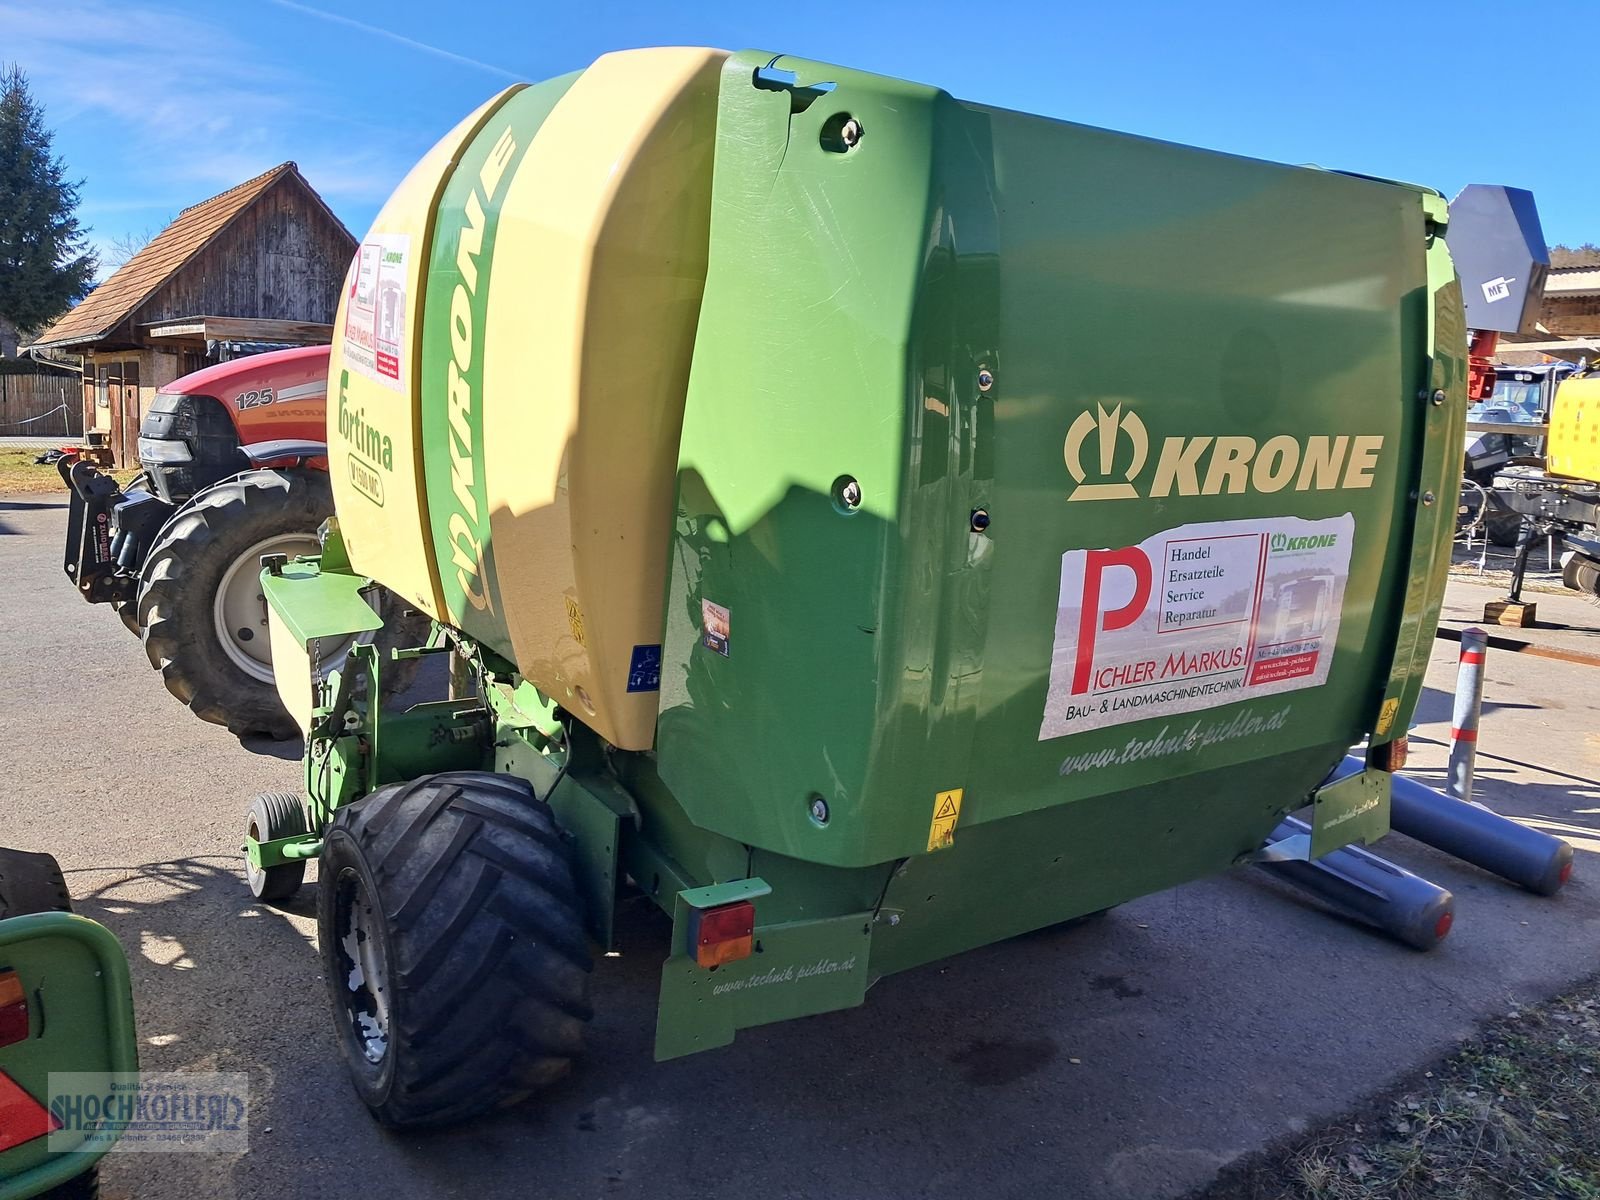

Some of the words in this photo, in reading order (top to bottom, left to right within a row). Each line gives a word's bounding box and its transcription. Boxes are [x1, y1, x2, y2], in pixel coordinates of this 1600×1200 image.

[1487, 284, 1504, 297] MF
[448, 124, 516, 527] KRONE
[235, 388, 273, 410] 125
[338, 368, 393, 472] Fortima
[1149, 434, 1384, 498] KRONE
[356, 465, 369, 491] 1500
[368, 475, 380, 499] MC
[1170, 546, 1211, 562] Handel
[1286, 533, 1337, 550] KRONE
[1168, 565, 1225, 583] Ersatzteile
[1166, 587, 1205, 604] Service
[1164, 606, 1217, 626] Reparatur
[1159, 647, 1243, 679] MARKUS
[1065, 706, 1096, 721] BAU-
[1099, 699, 1109, 714] &
[1112, 677, 1243, 711] LANDMASCHINENTECHNIK
[1059, 704, 1291, 776] www.technik-pichler.at
